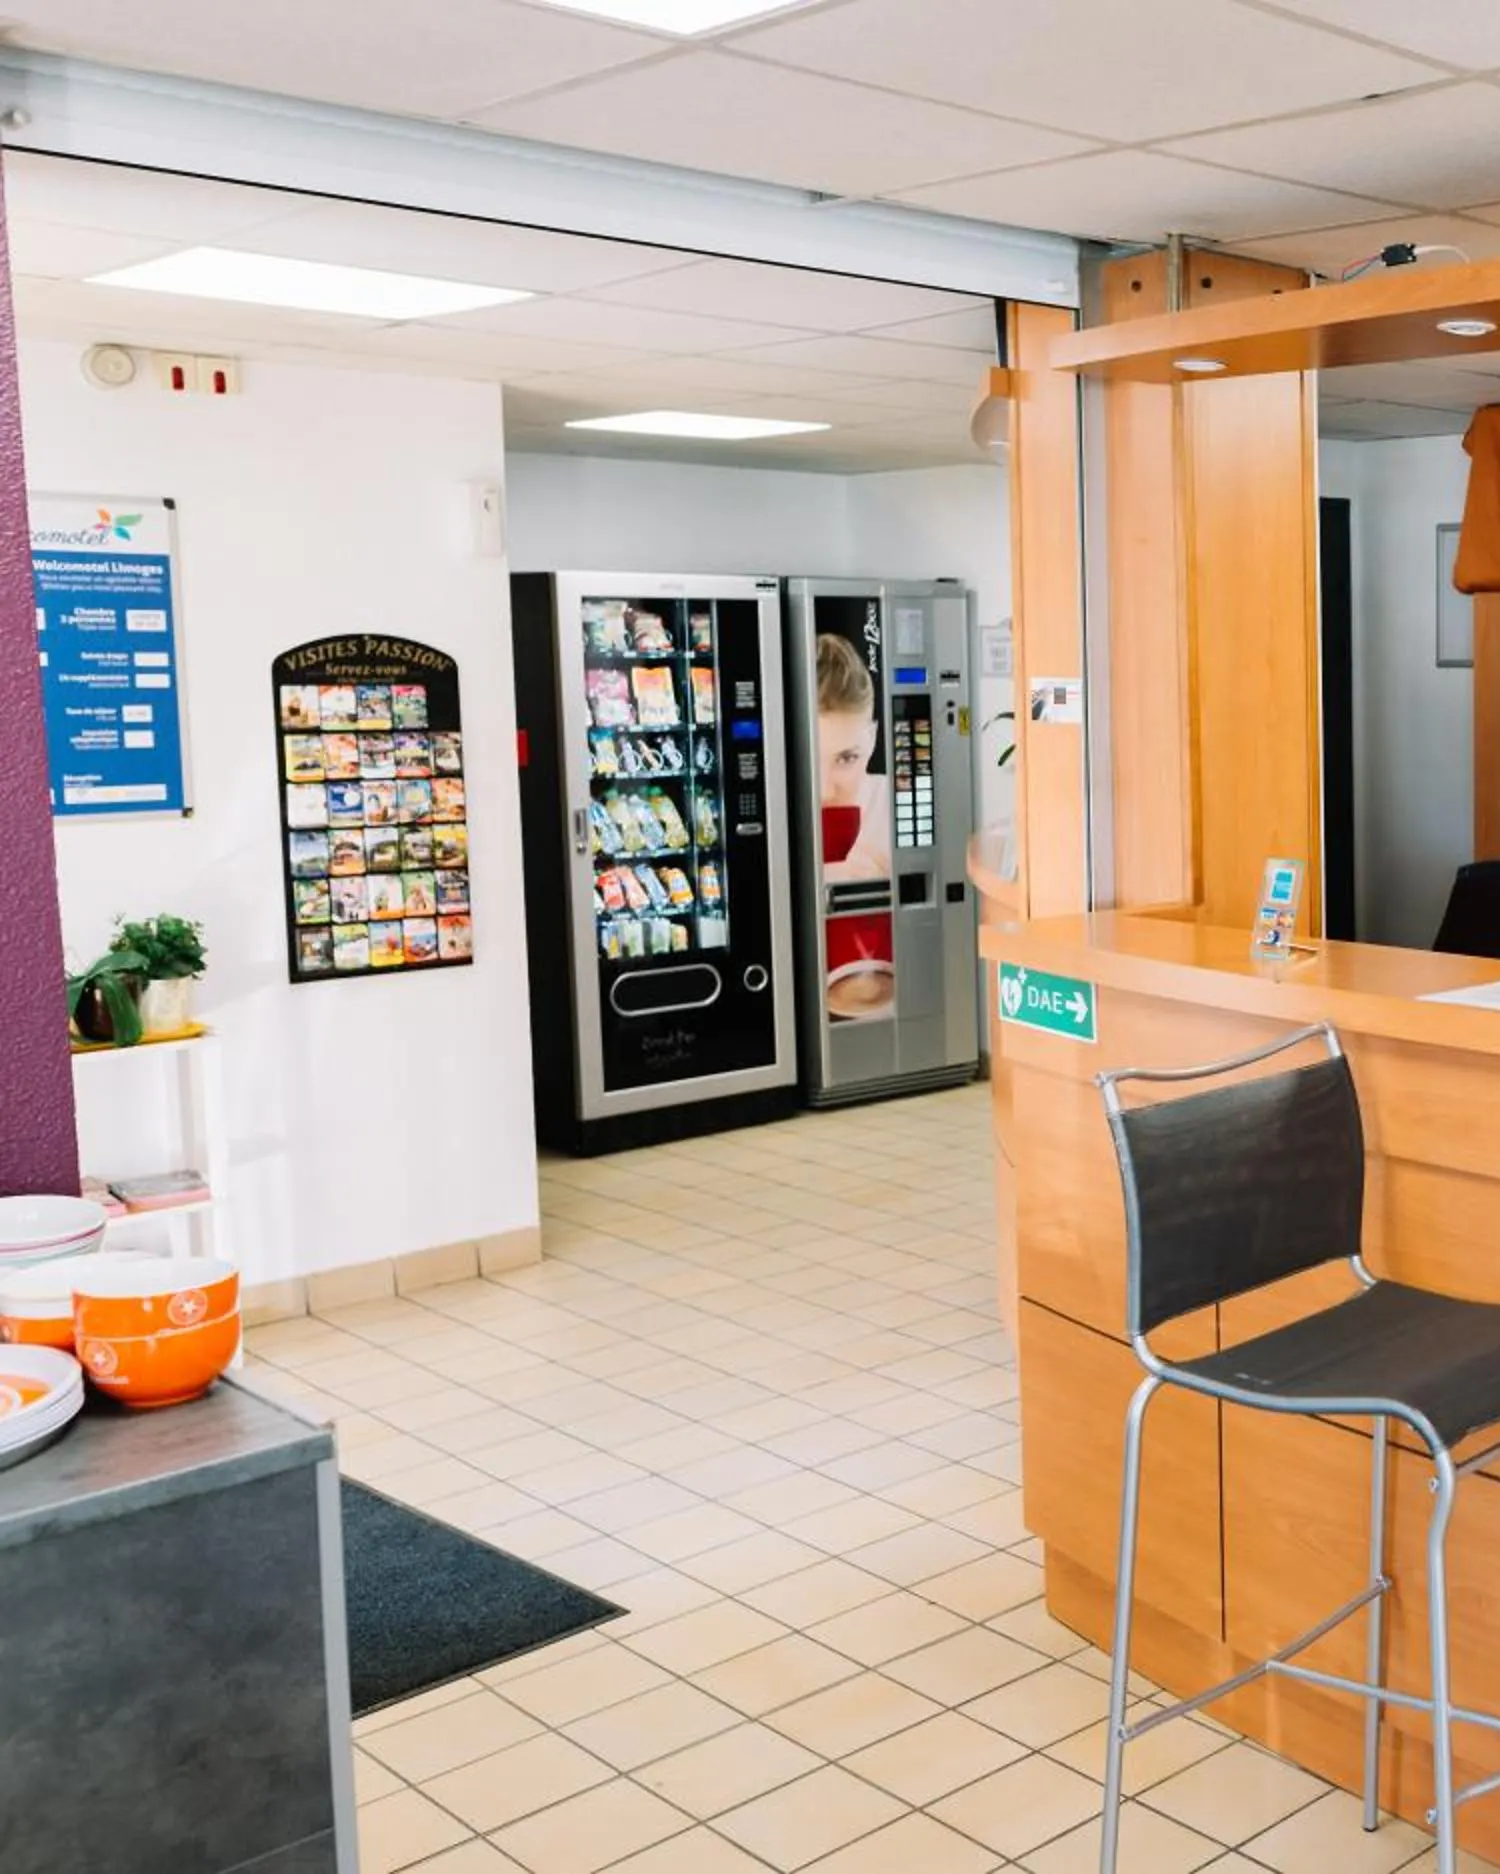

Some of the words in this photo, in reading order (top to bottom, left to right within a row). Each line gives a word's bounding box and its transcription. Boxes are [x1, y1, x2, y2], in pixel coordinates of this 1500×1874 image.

[111, 562, 163, 577] Limoges
[284, 639, 359, 671] VISITES
[364, 638, 451, 672] PASSION
[325, 662, 408, 677] Servez-vous
[1027, 985, 1064, 1015] DAE
